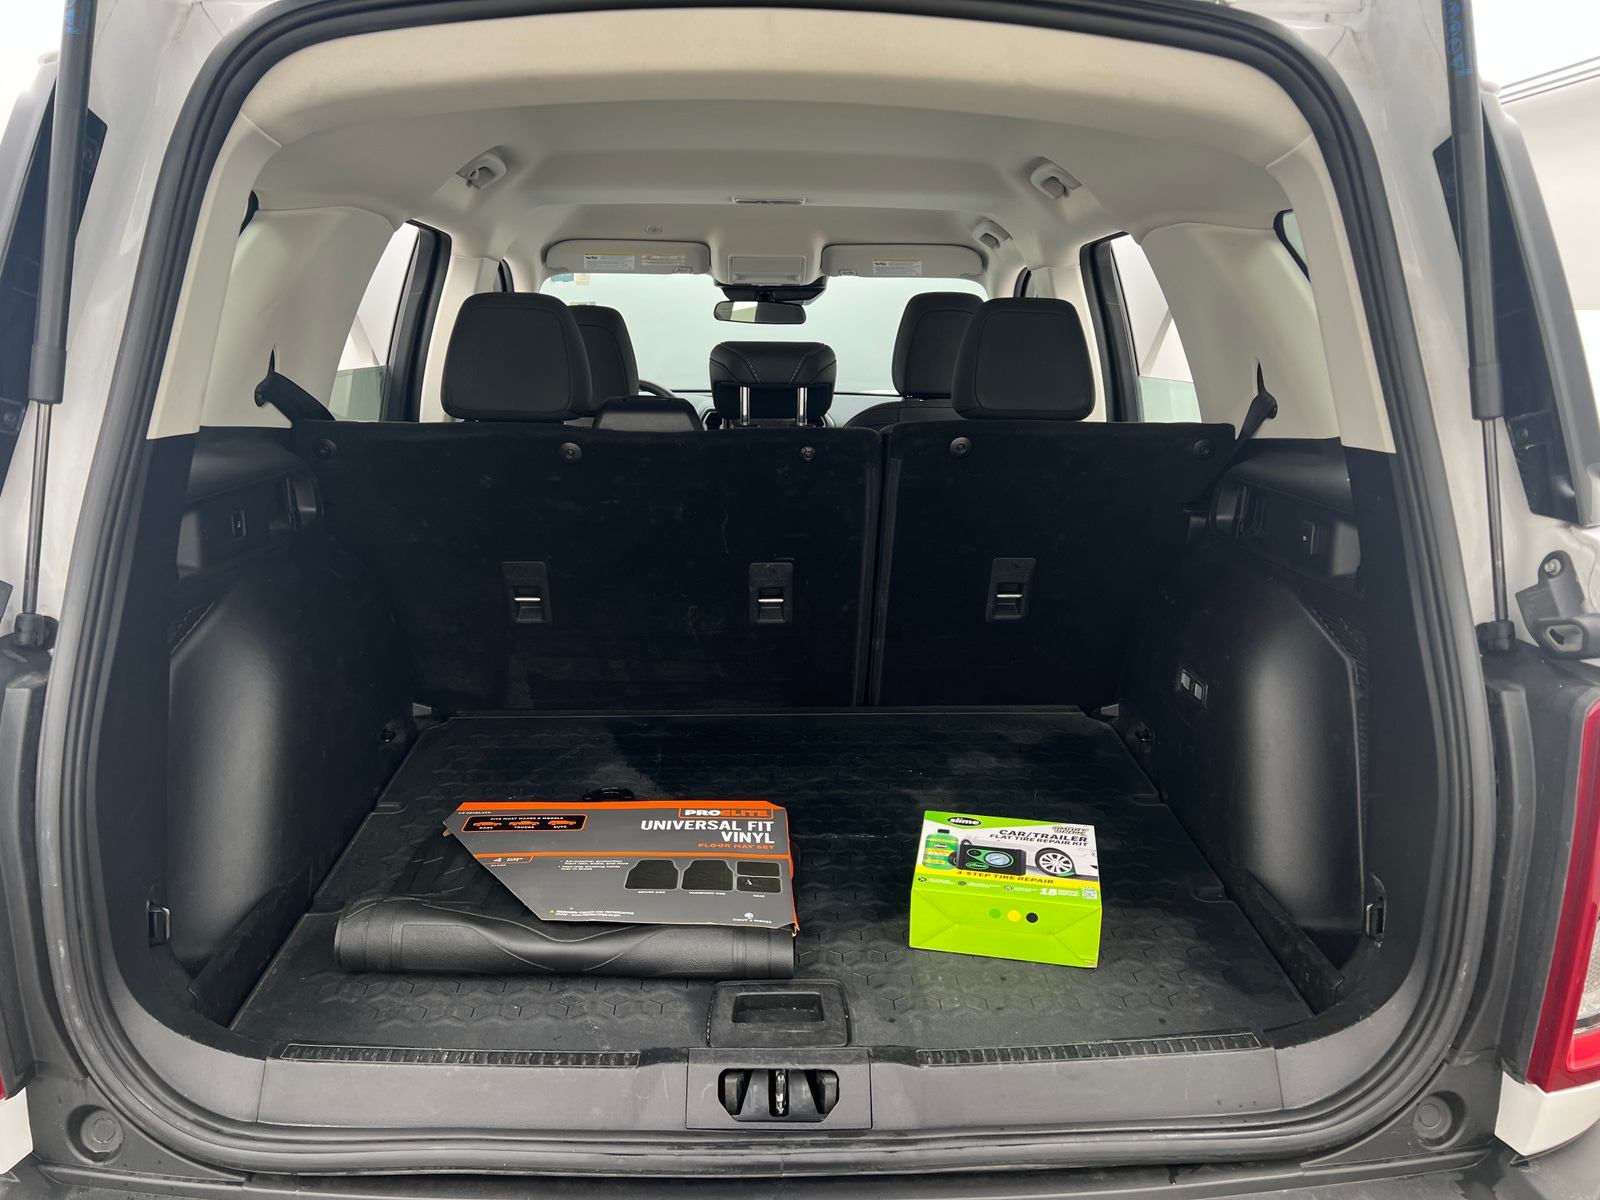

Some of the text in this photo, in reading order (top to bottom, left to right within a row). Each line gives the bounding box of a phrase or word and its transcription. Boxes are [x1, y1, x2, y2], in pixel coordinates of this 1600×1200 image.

[684, 809, 768, 817] PROELITE
[640, 820, 775, 832] UNIVERSAL FIT
[949, 817, 980, 826] slime
[720, 831, 776, 844] VINYL
[998, 829, 1088, 842] CAR/TRAILER
[1040, 888, 1057, 896] 15
